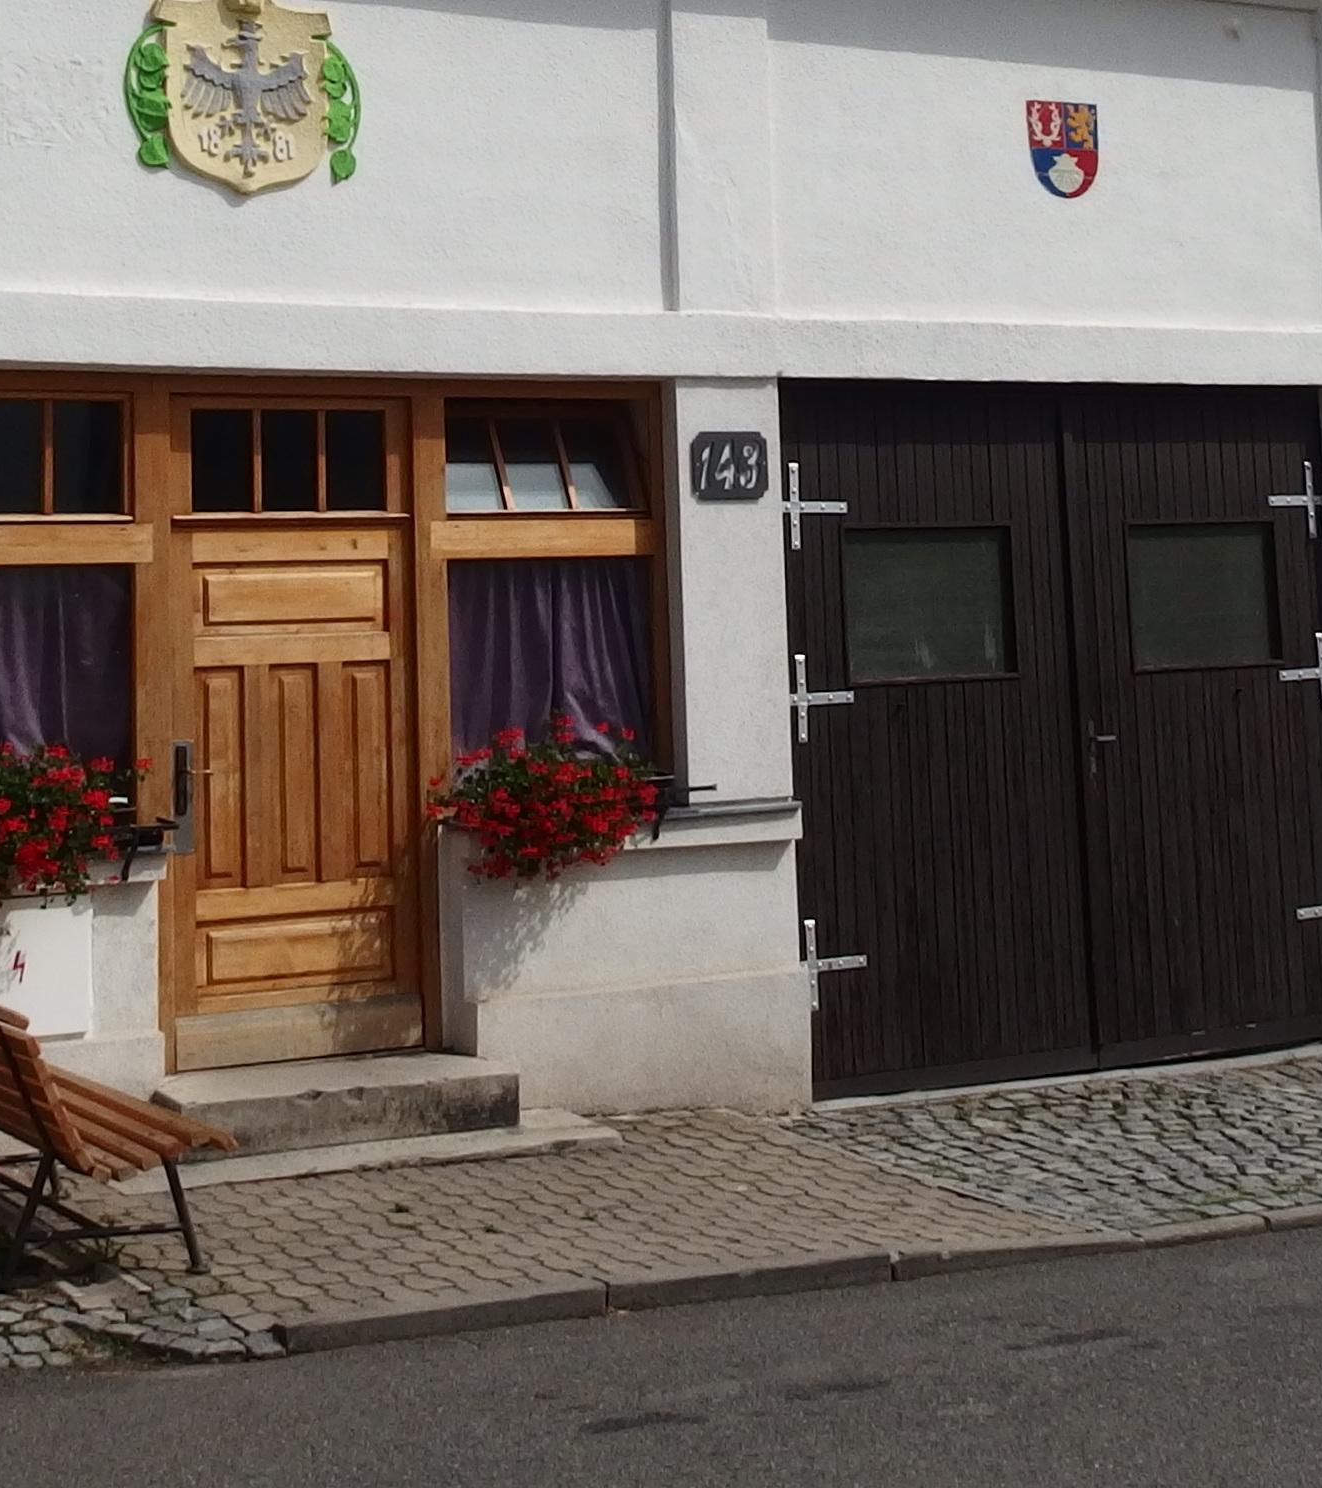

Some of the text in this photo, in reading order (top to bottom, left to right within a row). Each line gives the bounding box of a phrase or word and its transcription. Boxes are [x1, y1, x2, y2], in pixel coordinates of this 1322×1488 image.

[198, 126, 295, 163] 18 81
[700, 443, 758, 491] 143
